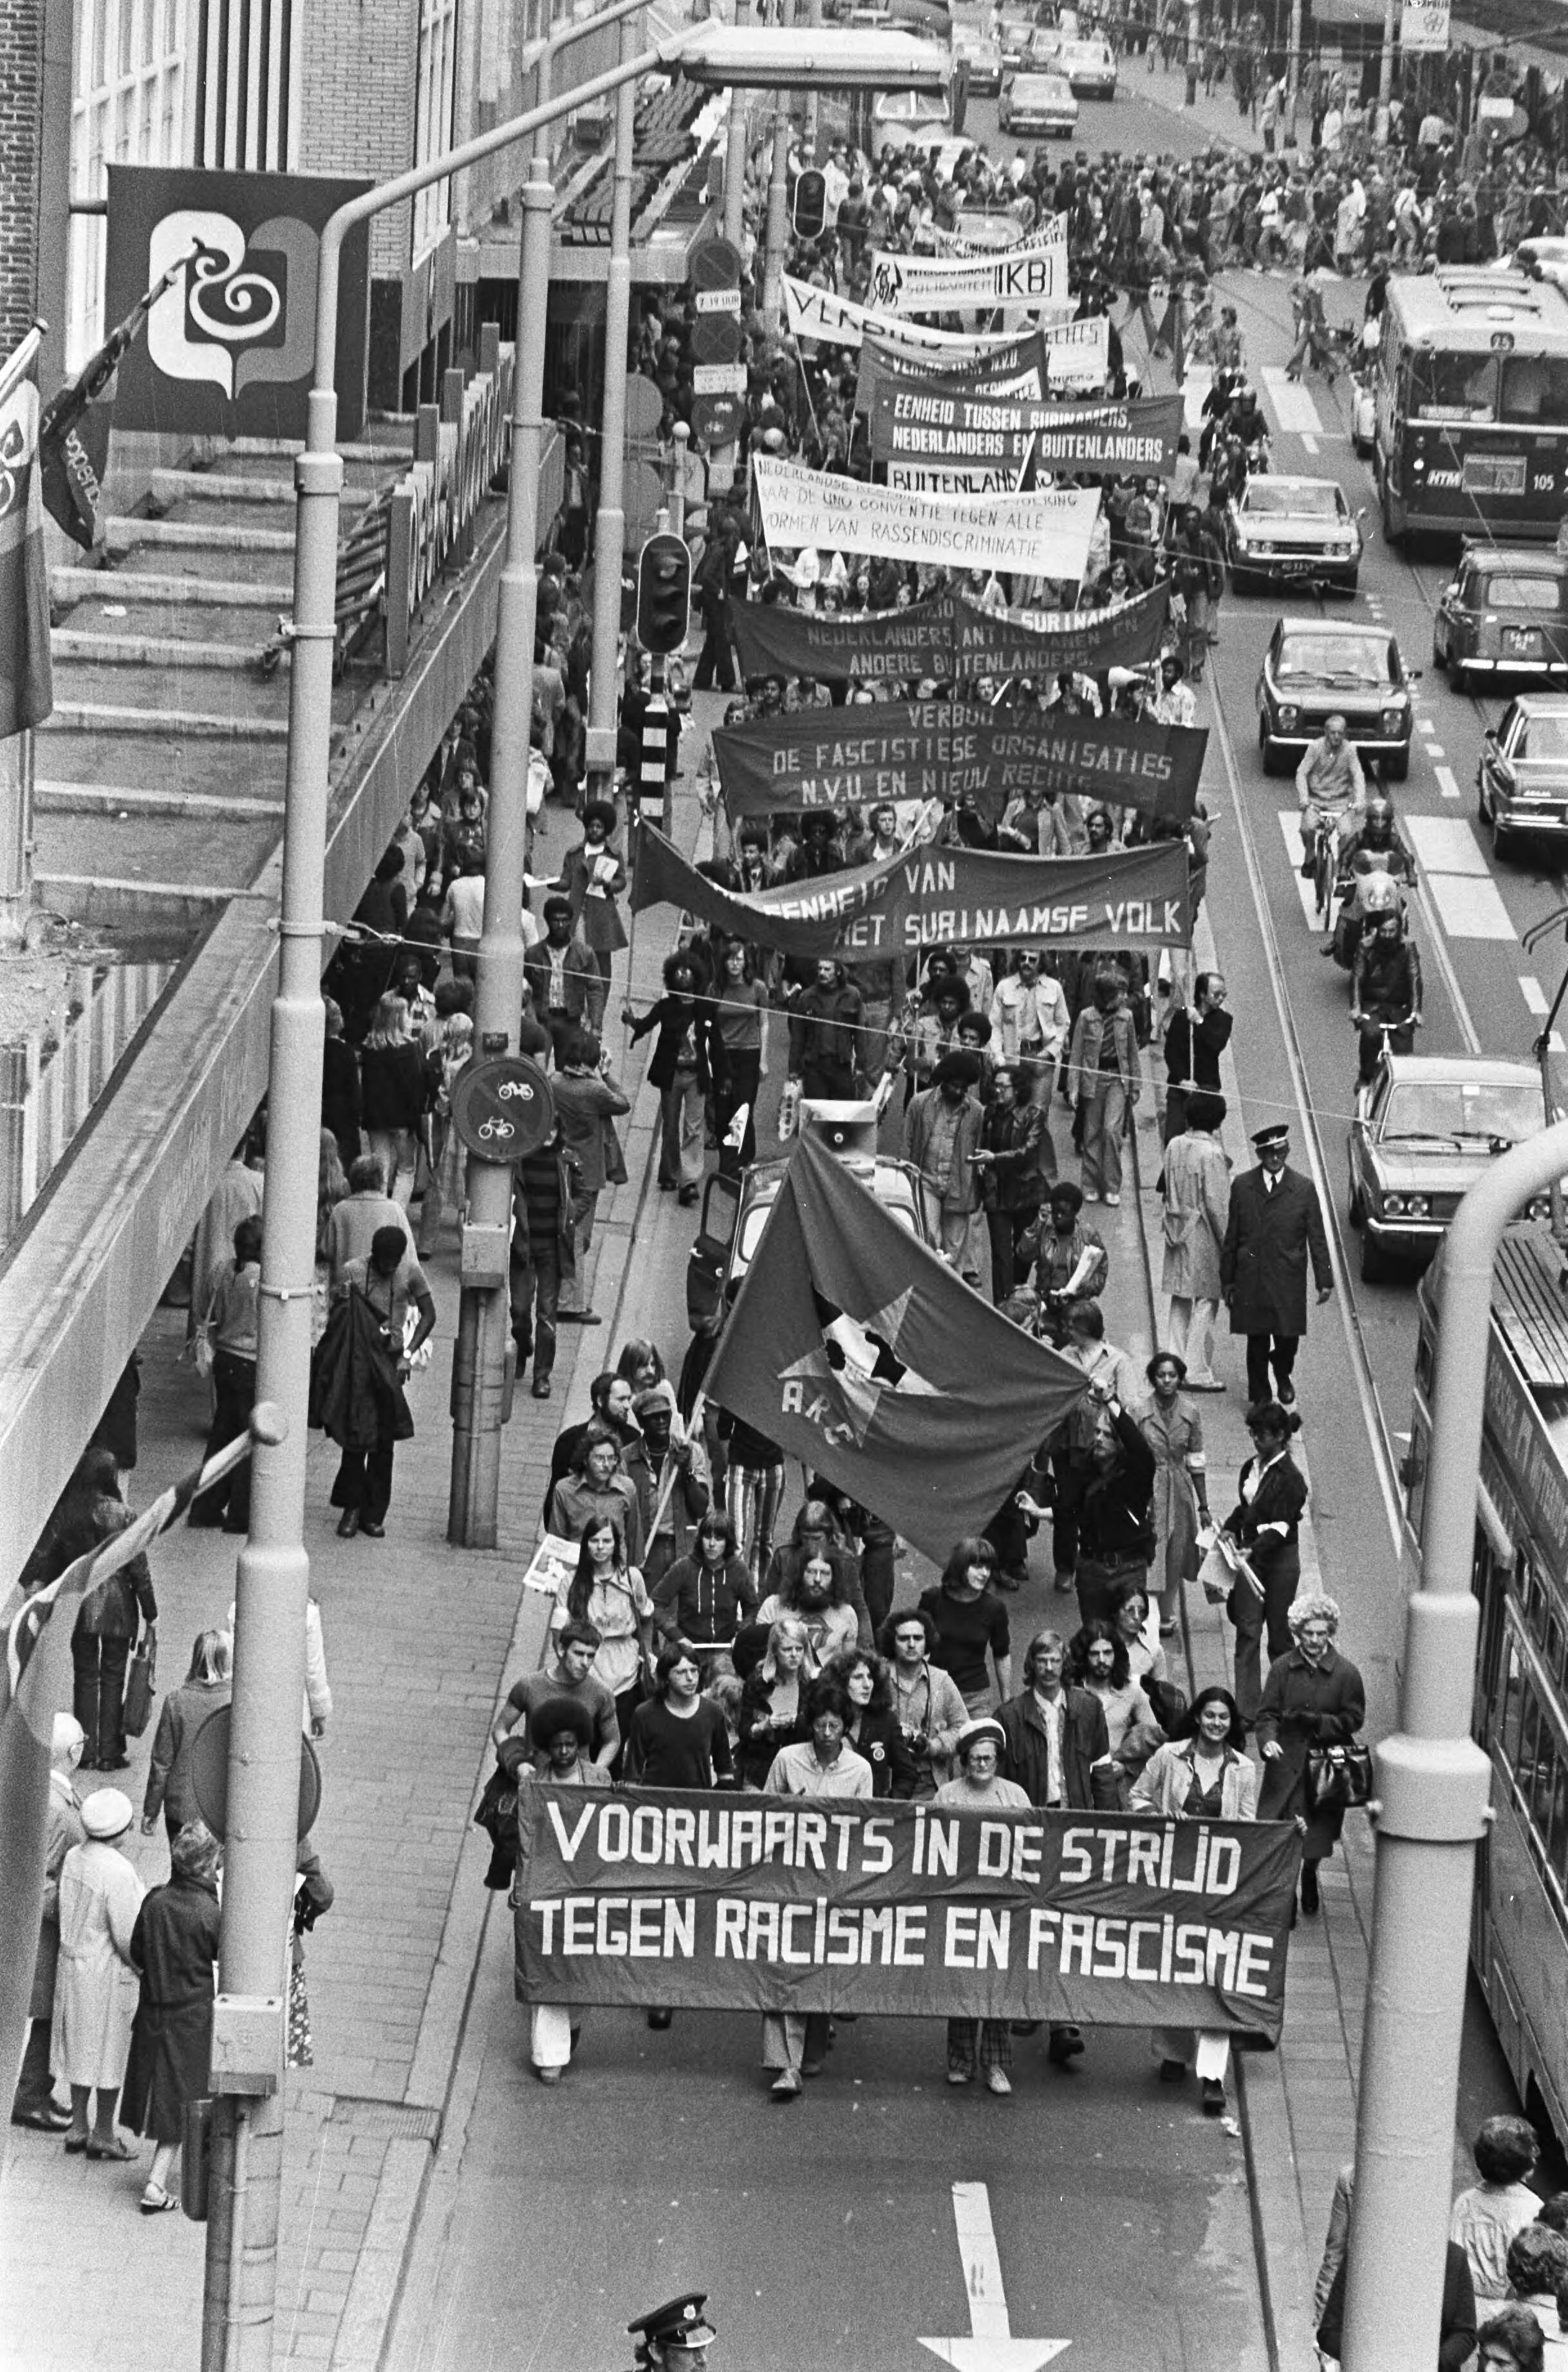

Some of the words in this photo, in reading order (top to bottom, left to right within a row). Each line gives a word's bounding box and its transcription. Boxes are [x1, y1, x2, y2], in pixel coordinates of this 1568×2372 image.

[998, 262, 1045, 294] IKB
[894, 393, 955, 424] EENHEID
[964, 403, 1022, 431] TUSSEN
[893, 426, 1004, 457] NEDERLANDERS
[1041, 433, 1163, 463] BUITENLANDERS
[1427, 469, 1462, 487] HTM
[1534, 474, 1555, 491] 105
[798, 487, 816, 504] DE
[860, 498, 940, 522] CONVENTIE
[952, 509, 997, 526] TEGEN
[1005, 513, 1043, 531] ALLE
[828, 517, 859, 537] VAN
[871, 522, 1040, 558] RASSENDISCRIMINATIE
[850, 654, 923, 675] ANDERE
[774, 749, 801, 775] DE
[816, 735, 977, 769] FASCISTIESE
[992, 734, 1173, 780] ORGANISATIES
[802, 774, 867, 804] N.V.U.
[877, 771, 906, 798] EN
[904, 861, 955, 894] VAN
[1105, 901, 1181, 933] VOLK
[546, 1802, 894, 1872] VOORWAARTS
[978, 1821, 1044, 1884] DE
[530, 1897, 695, 1958] TEGEN
[944, 1906, 1011, 1970] EN
